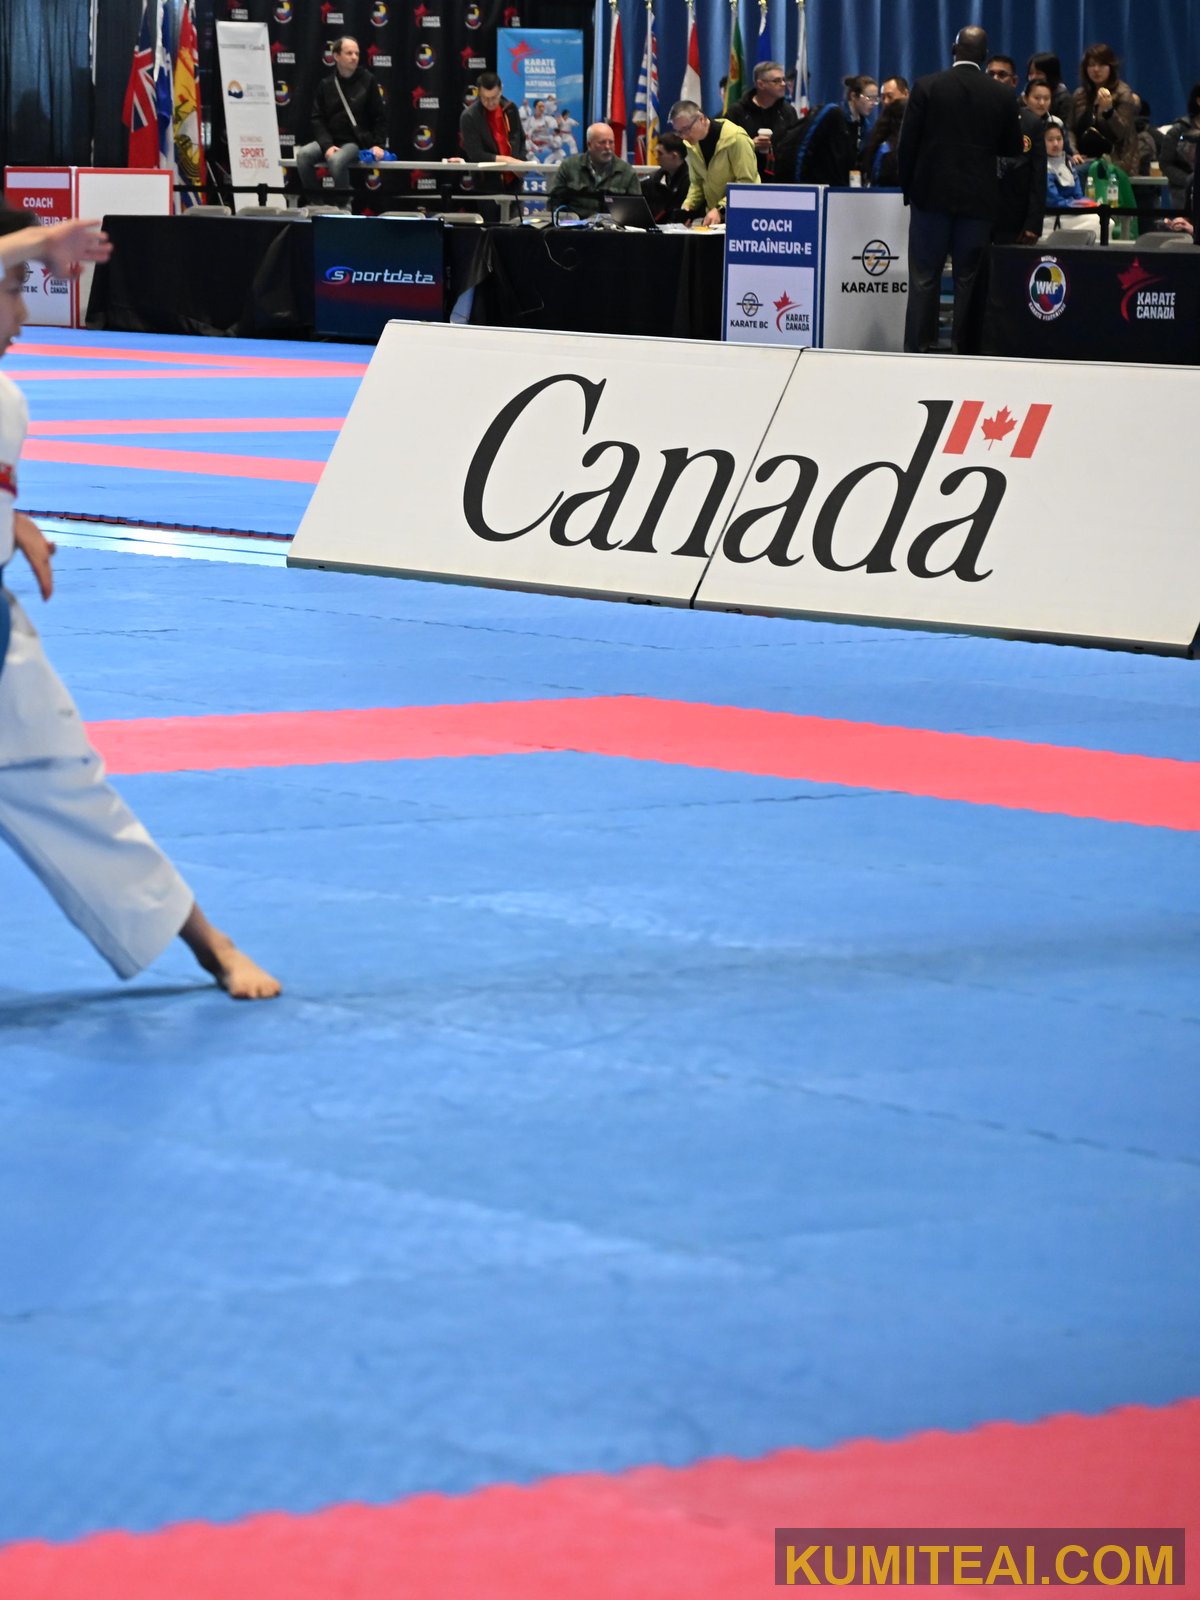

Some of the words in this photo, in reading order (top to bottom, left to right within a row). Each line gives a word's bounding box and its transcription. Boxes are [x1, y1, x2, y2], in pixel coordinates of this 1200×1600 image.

[240, 147, 265, 158] SPORT
[23, 197, 54, 208] COACH
[751, 218, 793, 232] COACH
[841, 281, 889, 293] KARATE
[892, 282, 908, 293] BC
[1036, 281, 1059, 295] WKF
[1137, 292, 1176, 306] KARATE
[785, 314, 810, 323] KARATE
[1136, 306, 1175, 320] CANADA
[730, 319, 758, 329] KARATE
[758, 320, 769, 329] BC
[785, 323, 810, 332] CANADA
[463, 373, 1008, 582] Canada
